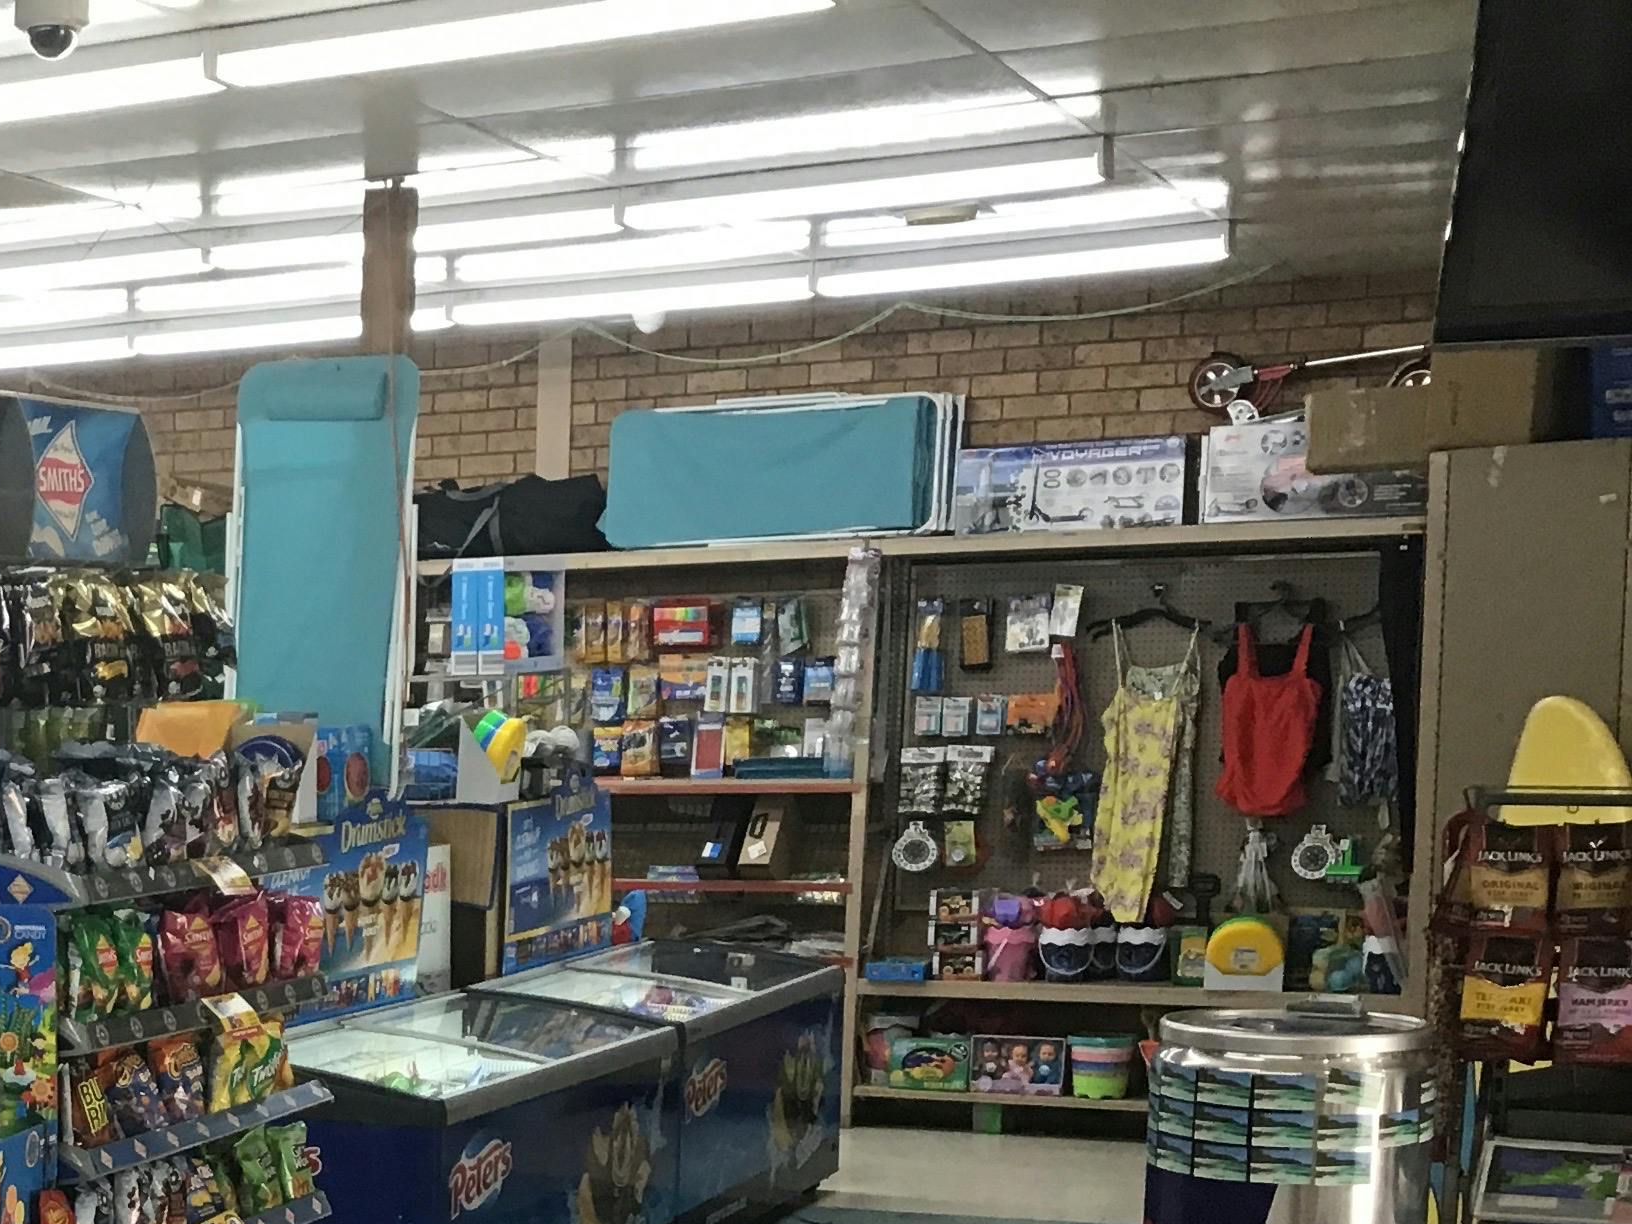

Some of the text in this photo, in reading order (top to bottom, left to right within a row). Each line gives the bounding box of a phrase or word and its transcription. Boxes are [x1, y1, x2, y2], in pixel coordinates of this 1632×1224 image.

[38, 462, 86, 493] SMITH'S
[1482, 880, 1539, 890] ORIGINAL
[1472, 961, 1504, 973] JACK
[1568, 966, 1598, 978] JACK
[685, 1057, 728, 1122] Peters
[450, 1138, 513, 1220] Peters
